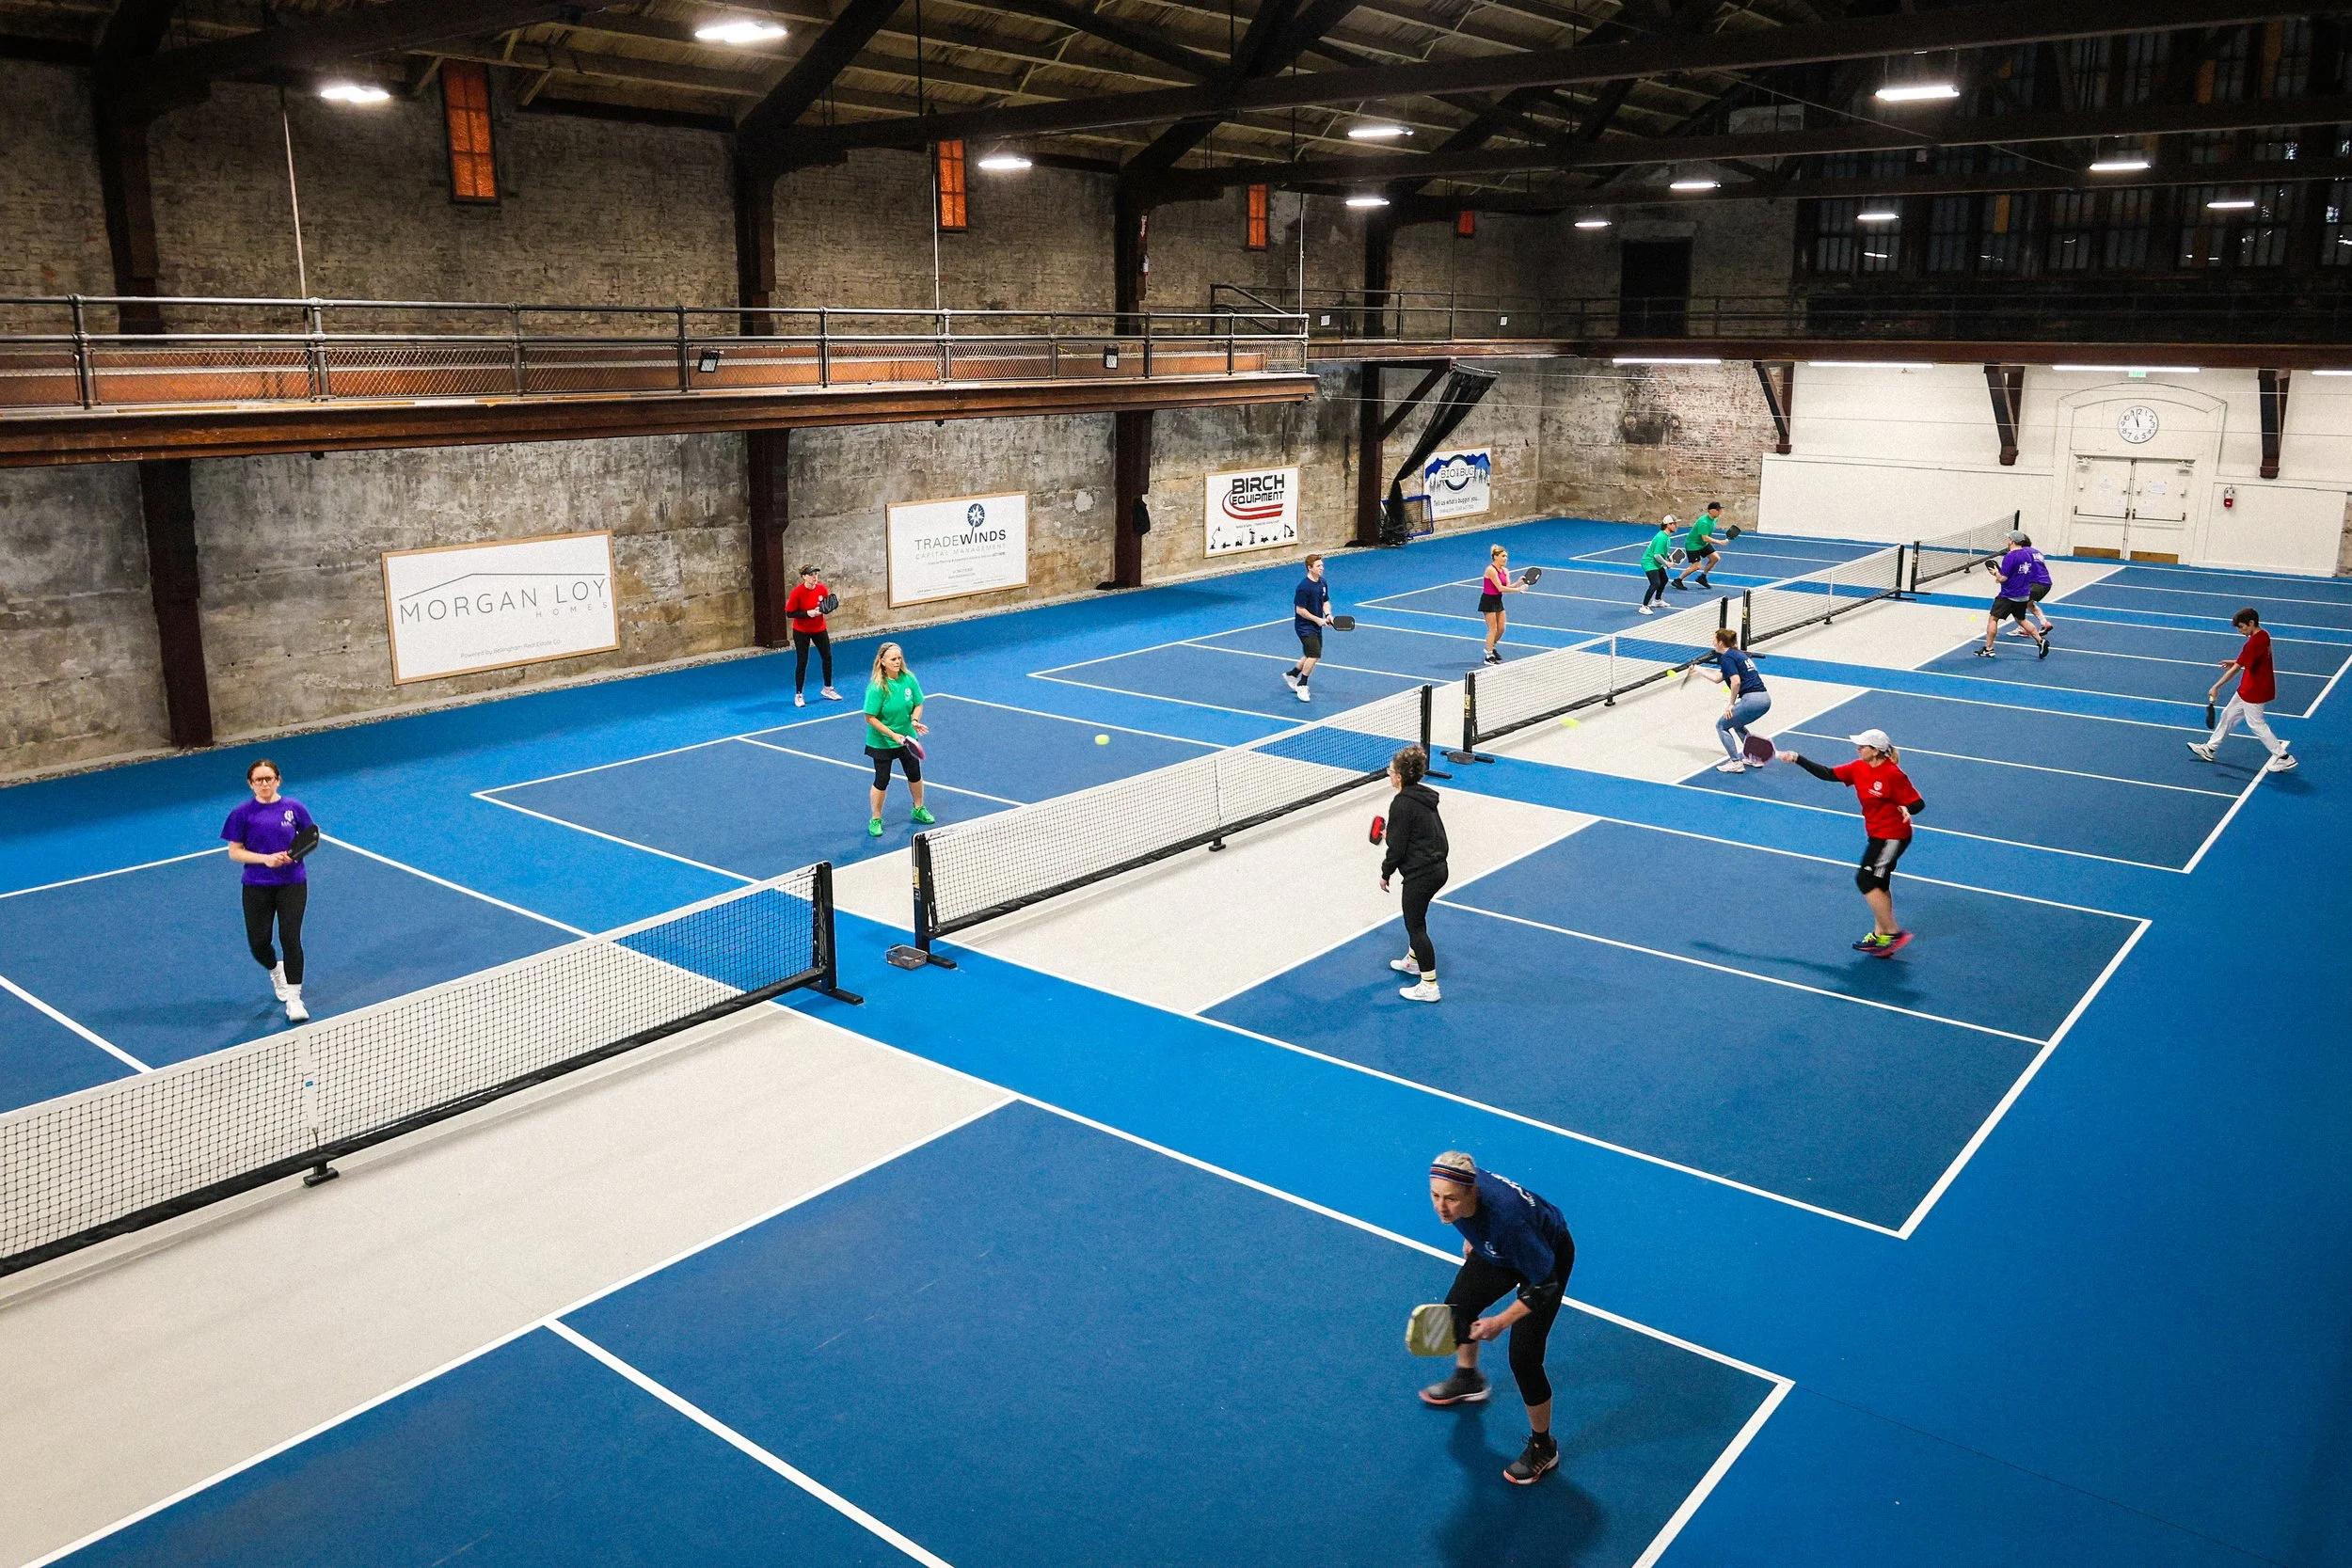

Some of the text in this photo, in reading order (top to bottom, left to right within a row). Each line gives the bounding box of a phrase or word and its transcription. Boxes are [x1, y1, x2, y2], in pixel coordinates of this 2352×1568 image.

[1232, 474, 1285, 494] BIRCH
[1232, 491, 1284, 505] EQUIPMENT
[914, 528, 1007, 550] TRADEWINDS
[915, 550, 948, 561] CAPITAL
[953, 543, 1006, 555] MANAGEMENT
[399, 578, 607, 625] MORGAN LOY
[535, 601, 608, 618] HOMES
